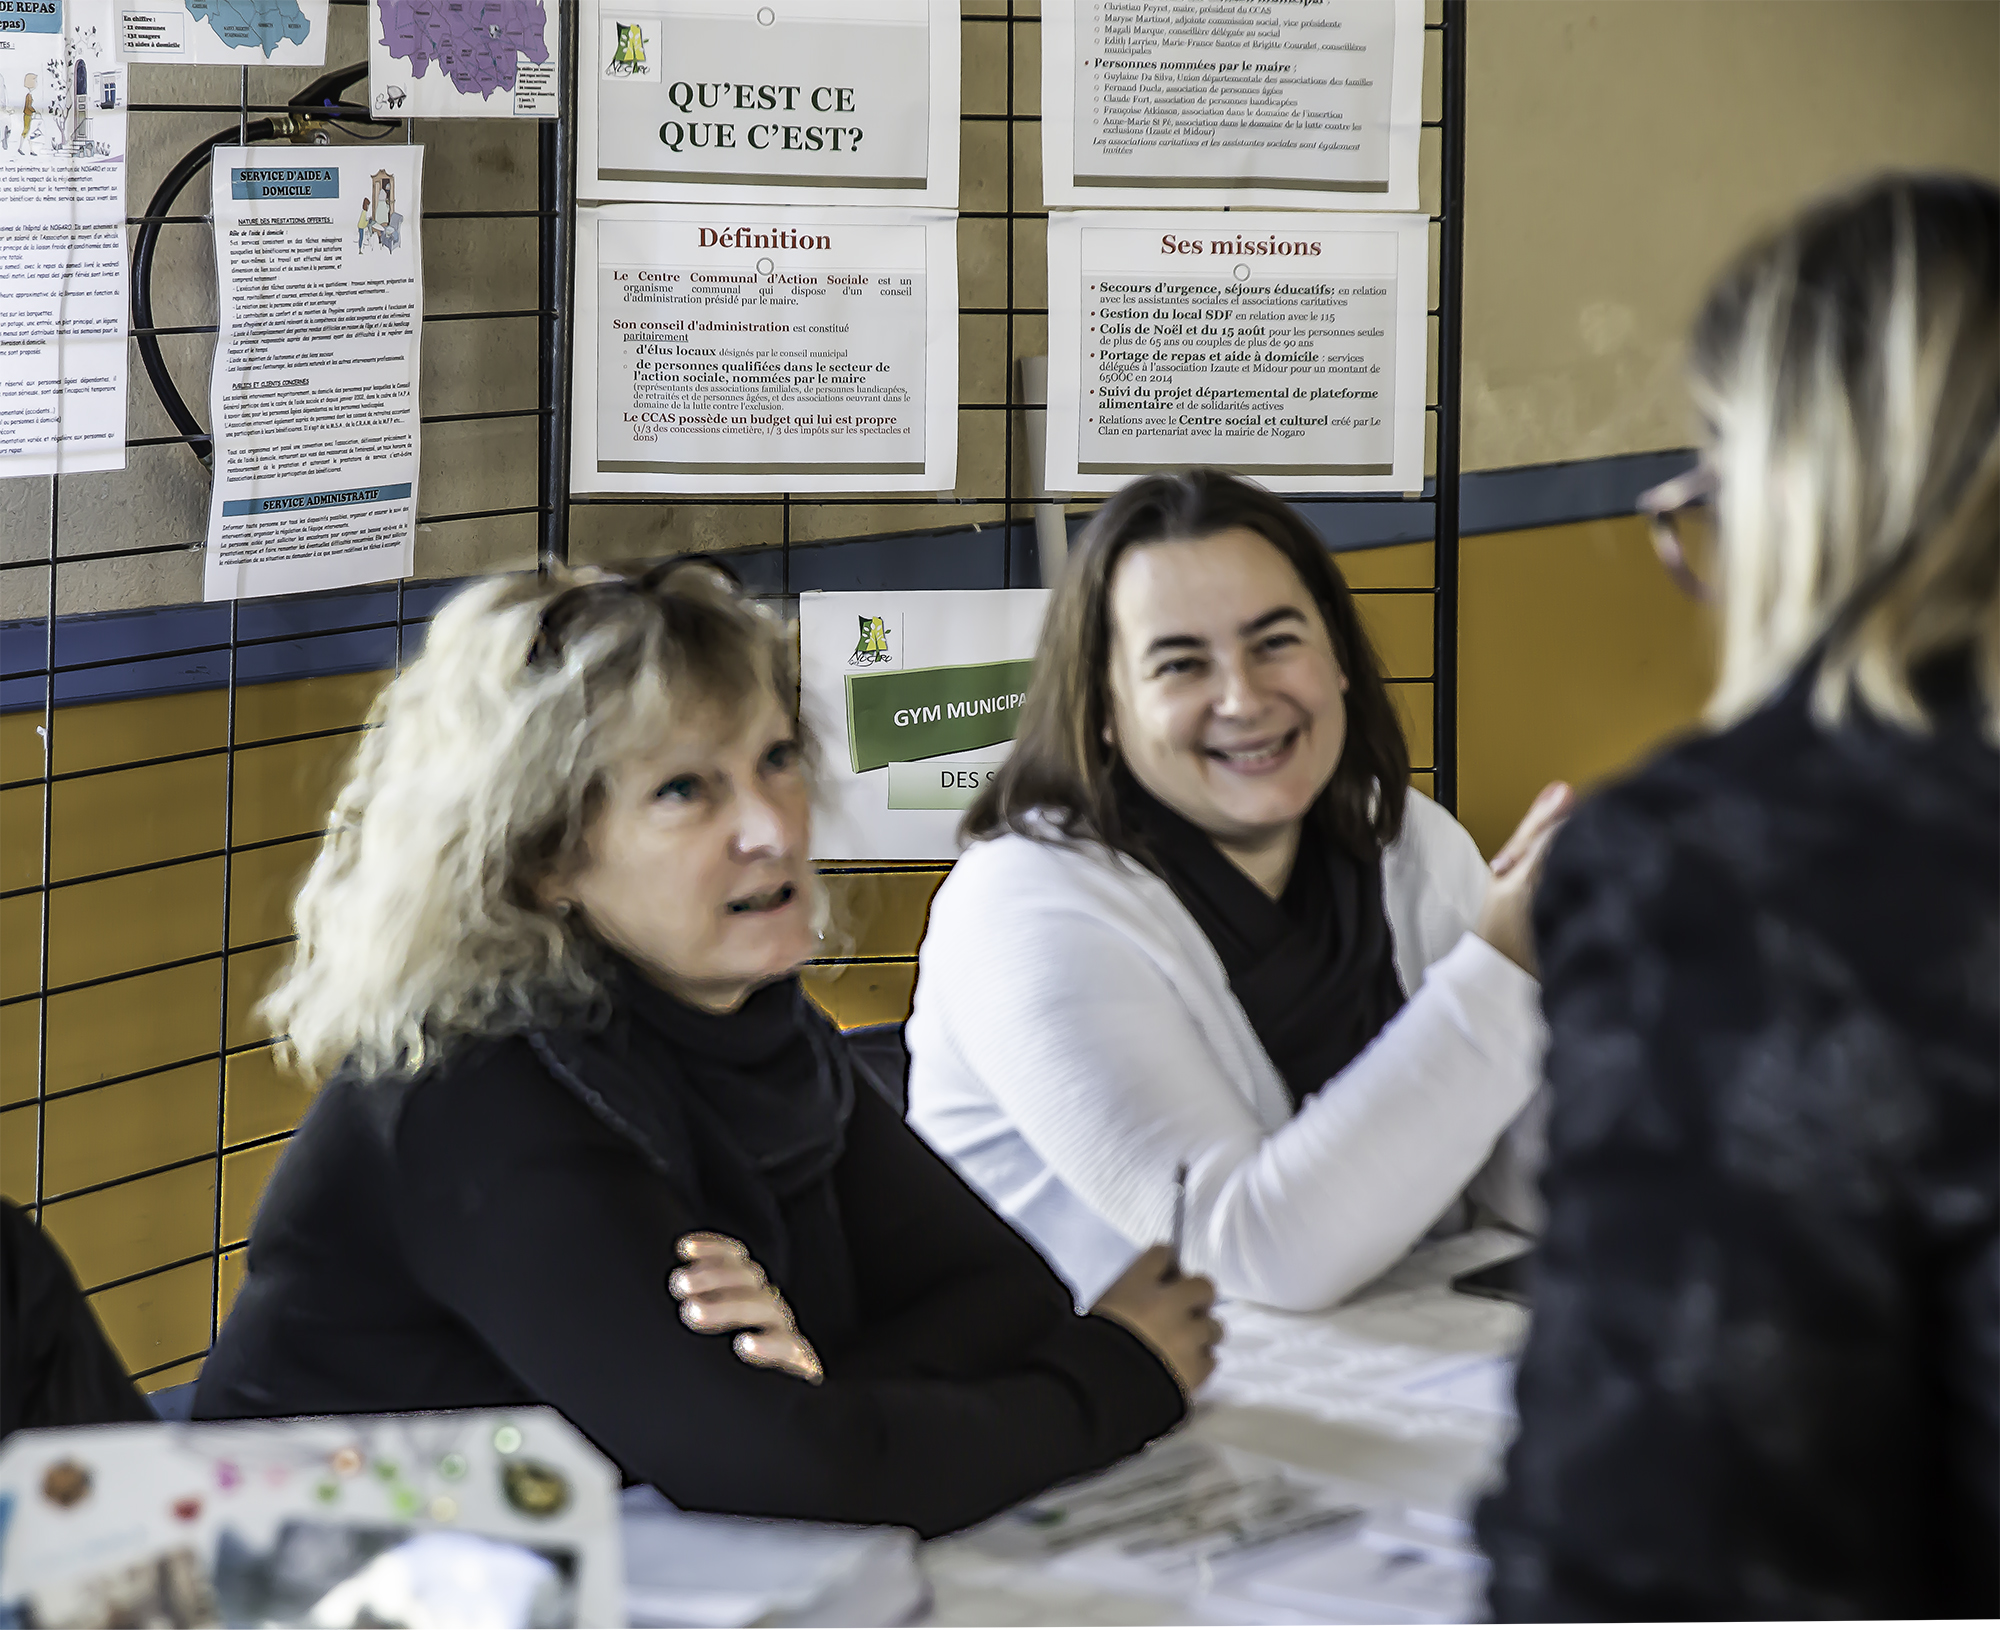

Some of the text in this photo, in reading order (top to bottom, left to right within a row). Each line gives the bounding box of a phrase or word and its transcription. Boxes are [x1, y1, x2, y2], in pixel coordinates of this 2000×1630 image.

[0, 18, 26, 31] epas)
[1094, 58, 1290, 73] Personnes nommées par le maire
[668, 81, 854, 113] QU'EST CE
[659, 121, 862, 153] QUE C'EST?
[240, 170, 331, 181] SERVICE D'AIDE A
[262, 186, 313, 195] DOMICILE
[698, 226, 831, 249] Définition
[1161, 234, 1321, 256] Ses missions
[614, 271, 628, 280] Le
[638, 271, 679, 281] Centre
[690, 272, 756, 283] Communal
[767, 274, 817, 284] d'Action
[827, 274, 868, 284] Sociale
[623, 283, 911, 296] organisme communal qui dispose d'un conseil
[1100, 282, 1151, 292] Secours
[1154, 282, 1220, 296] d'urgence,
[1224, 283, 1270, 296] séjours
[1352, 286, 1386, 295] relation
[623, 292, 798, 306] d'administration présidé par le maire.
[1100, 308, 1148, 318] Gestion
[1152, 308, 1168, 319] du
[1172, 308, 1201, 319] local
[1205, 310, 1232, 320] SDF
[1249, 311, 1285, 320] relation
[1310, 311, 1318, 320] le
[1320, 314, 1334, 323] 115
[613, 319, 636, 329] Son
[640, 319, 683, 330] conseil
[687, 320, 789, 332] d'administration
[808, 323, 849, 332] constitué
[1100, 323, 1384, 338] Colis de Noël et du 15 août pour les personnes seules
[623, 330, 688, 343] paritairement
[636, 344, 672, 354] d'élus
[676, 345, 715, 355] locaux
[719, 348, 753, 358] désignés
[771, 348, 778, 356] le
[779, 349, 807, 357] conseil
[810, 349, 847, 359] municipal
[1100, 350, 1364, 364] Portage de repas et aide à domicile services
[635, 359, 889, 373] de personnes qualifiées dans le secteur de
[634, 370, 865, 386] l'action sociale, nommées par le maire
[1099, 386, 1378, 401] Suivi du projet départemental de plateforme
[1098, 399, 1173, 410] alimentaire
[1187, 400, 1198, 409] de
[1200, 400, 1249, 410] solidarités
[1251, 400, 1283, 410] actives
[623, 412, 637, 422] Le
[641, 412, 675, 422] CCAS
[679, 413, 728, 425] possède
[750, 414, 790, 426] budget
[794, 414, 813, 426] qui
[817, 414, 831, 424] lui
[835, 415, 851, 424] est
[855, 417, 896, 427] propre
[263, 489, 380, 510] SERVICE ADMINISTRATIF
[947, 692, 1028, 719] MUNICIPA
[941, 771, 980, 788] DES
